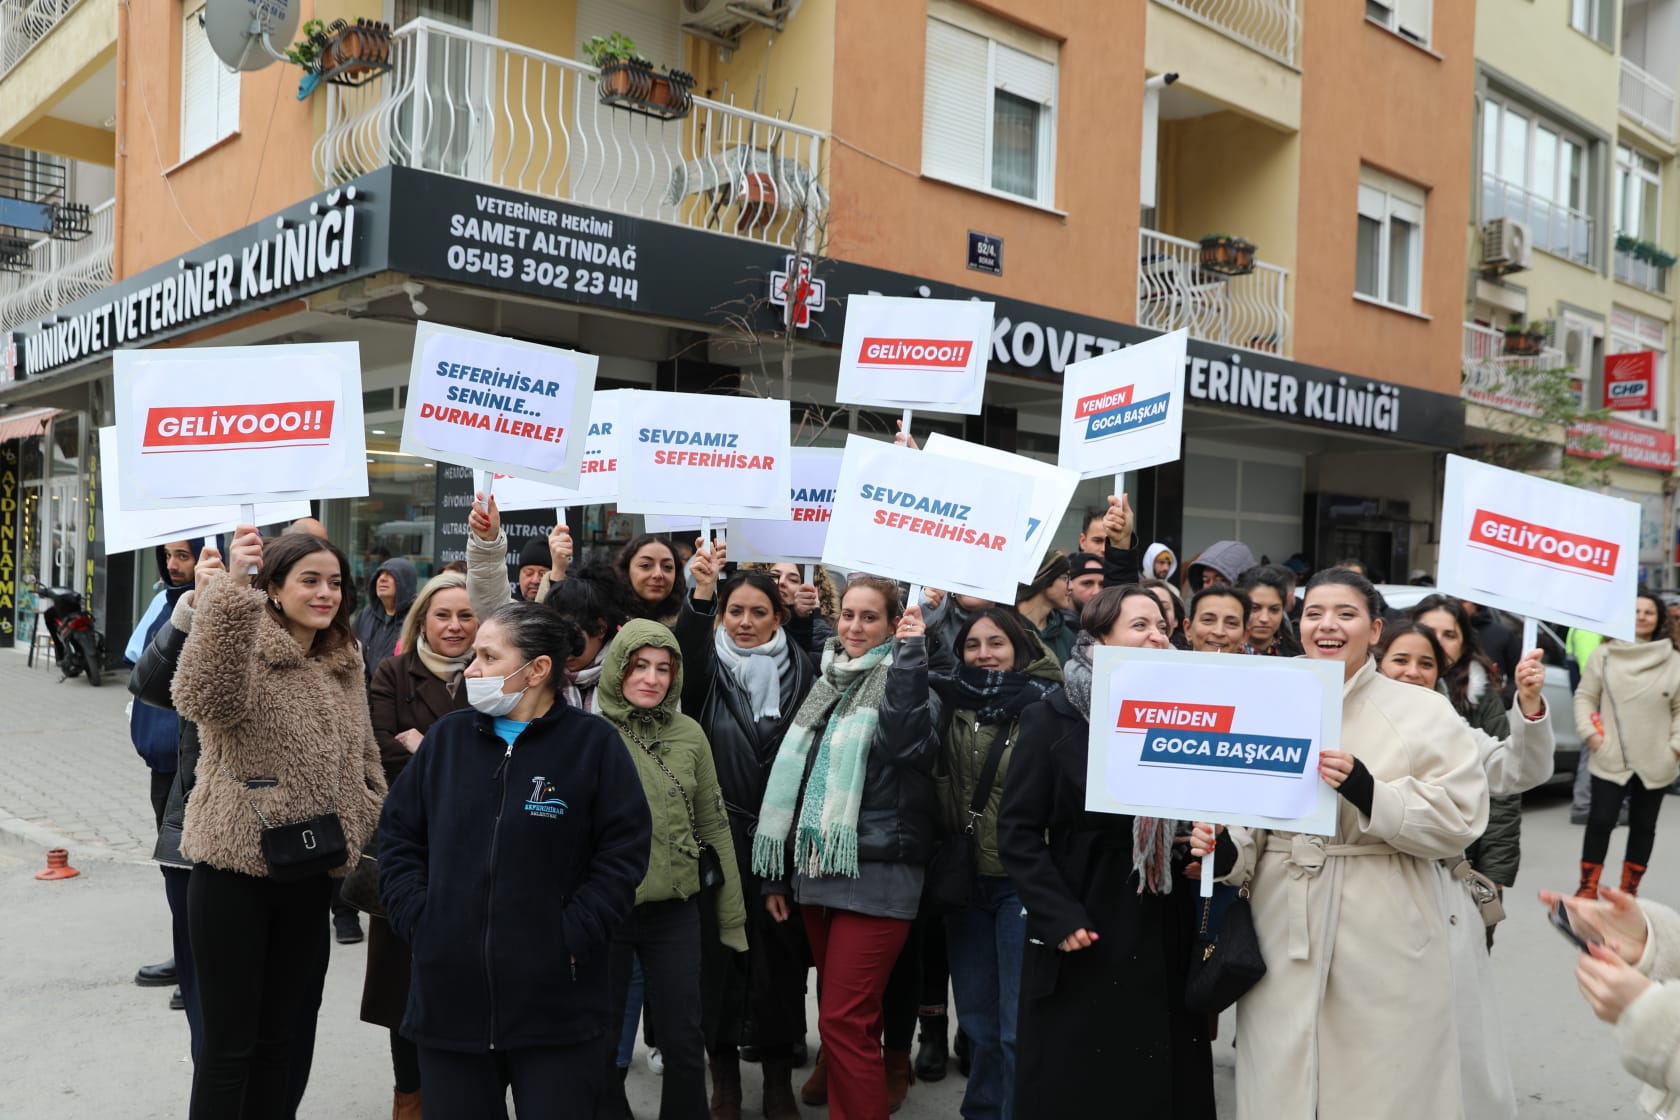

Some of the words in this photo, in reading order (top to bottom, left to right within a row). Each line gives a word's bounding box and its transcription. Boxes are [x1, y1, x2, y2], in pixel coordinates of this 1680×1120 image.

[475, 194, 558, 227] VETERİNER
[561, 213, 613, 238] HEKİMİ
[450, 214, 530, 249] SAMET
[532, 231, 637, 271] ALTINDAĞ
[25, 301, 113, 375] MİNİKOVET
[112, 254, 234, 344] VETERİNER
[240, 186, 356, 300] KLİNİĞİ
[447, 245, 514, 278] 0543
[520, 258, 569, 289] 302
[574, 269, 604, 294] 23
[608, 275, 639, 301] 44
[867, 341, 965, 362] GELİYOOO!!
[436, 361, 560, 397] SEFERİHİSAR
[987, 315, 1121, 374] KOVET
[1186, 353, 1299, 415] ERİNER
[1304, 376, 1400, 432] KLİNİĞİ
[1611, 382, 1644, 396] CHP
[446, 386, 541, 417] SENİNLE...
[1082, 392, 1126, 413] YENİDEN
[1091, 415, 1122, 431] GOCA
[1124, 400, 1167, 423] BAŞKAN
[158, 410, 322, 437] GELİYOOO!!
[420, 403, 491, 430] DURMA
[494, 413, 564, 443] İLERLE!
[638, 428, 739, 447] SEVDAMIZ
[580, 458, 617, 473] ERLE
[654, 449, 775, 470] SEFERİHİSAR
[860, 483, 972, 520] SEVDAMIZ
[0, 470, 17, 610] AYDINLATMA
[873, 508, 1007, 551] SEFERİHİSAR
[1480, 520, 1611, 567] GELİYOOO!!
[1133, 705, 1217, 728] YENİDEN
[1151, 737, 1211, 756] GOCA
[1216, 742, 1302, 764] BAŞKAN
